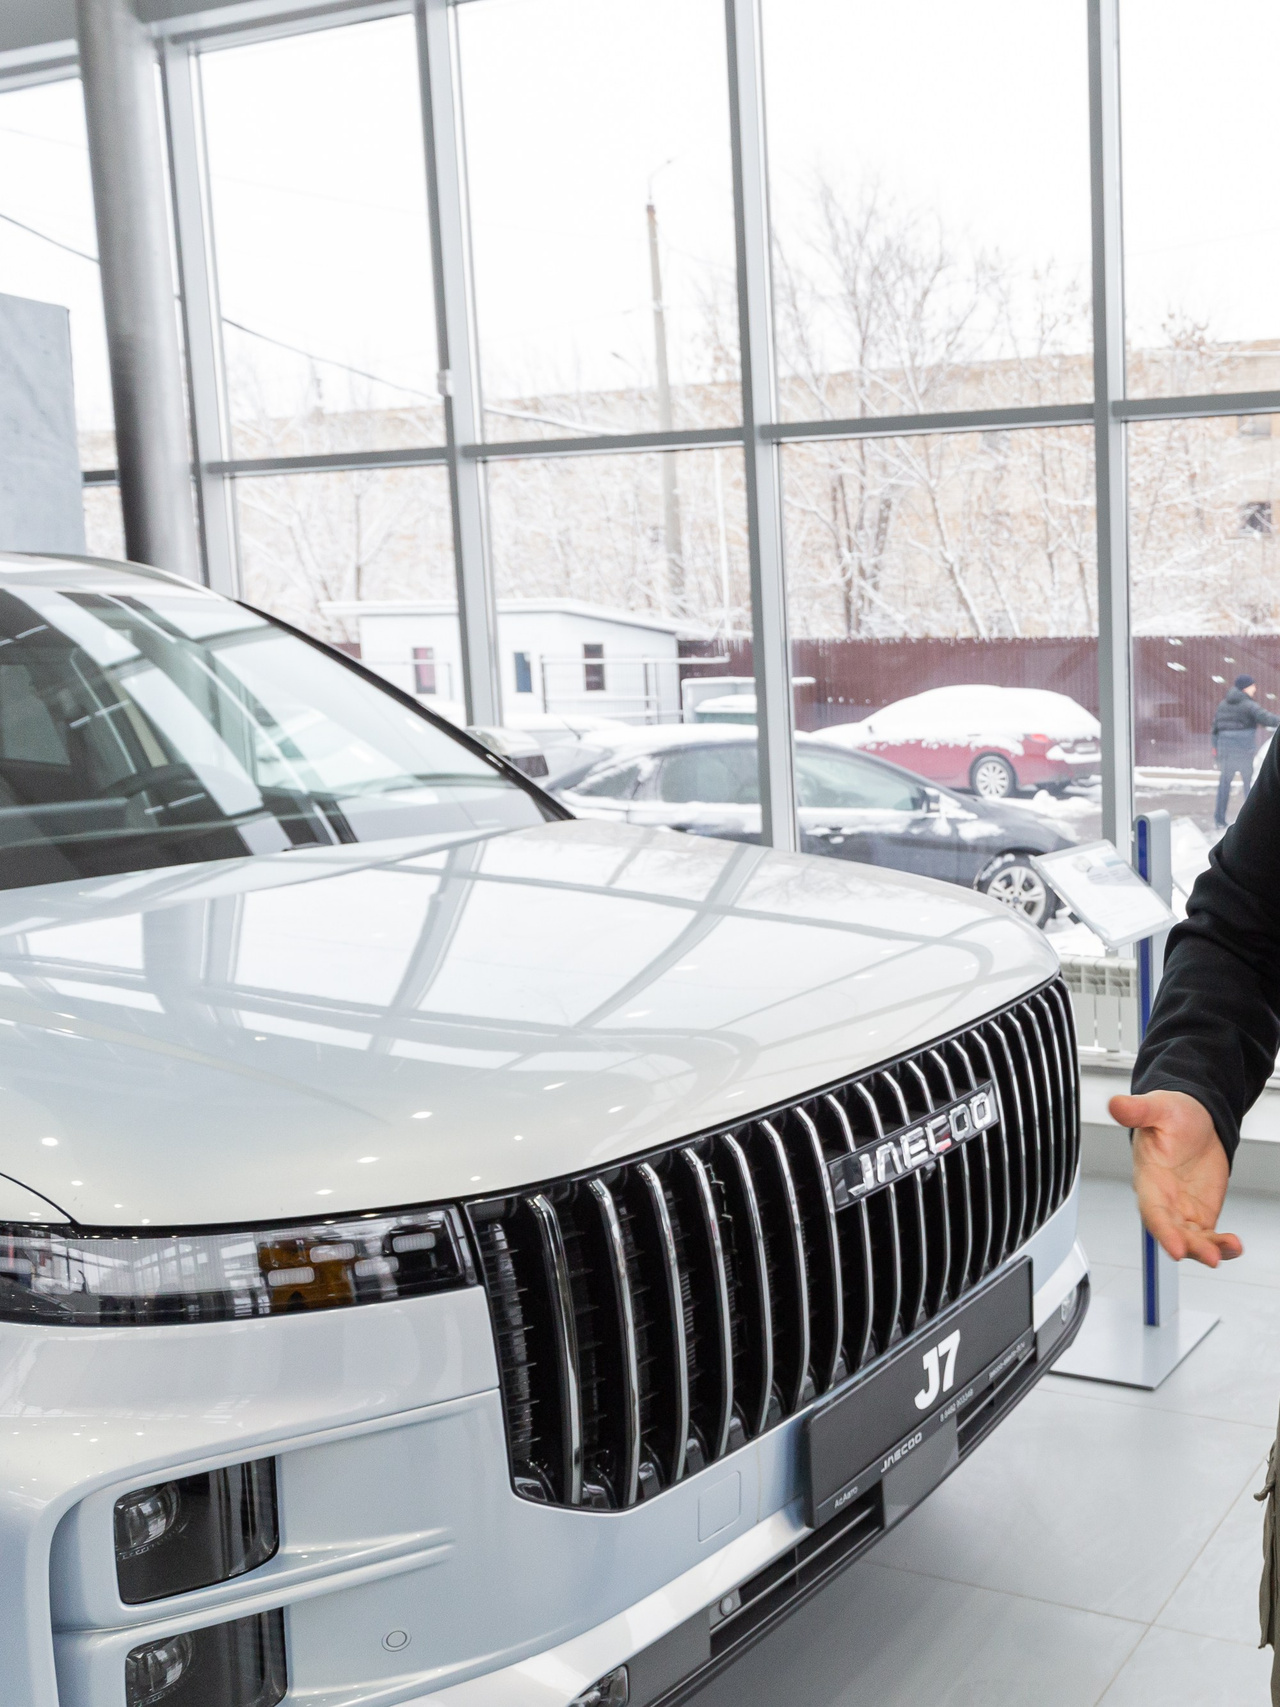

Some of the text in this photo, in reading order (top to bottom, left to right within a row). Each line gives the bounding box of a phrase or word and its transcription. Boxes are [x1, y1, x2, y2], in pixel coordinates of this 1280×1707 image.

[848, 1092, 992, 1196] JAECOO
[914, 1329, 960, 1410] J7
[880, 1432, 922, 1473] JAECOO
